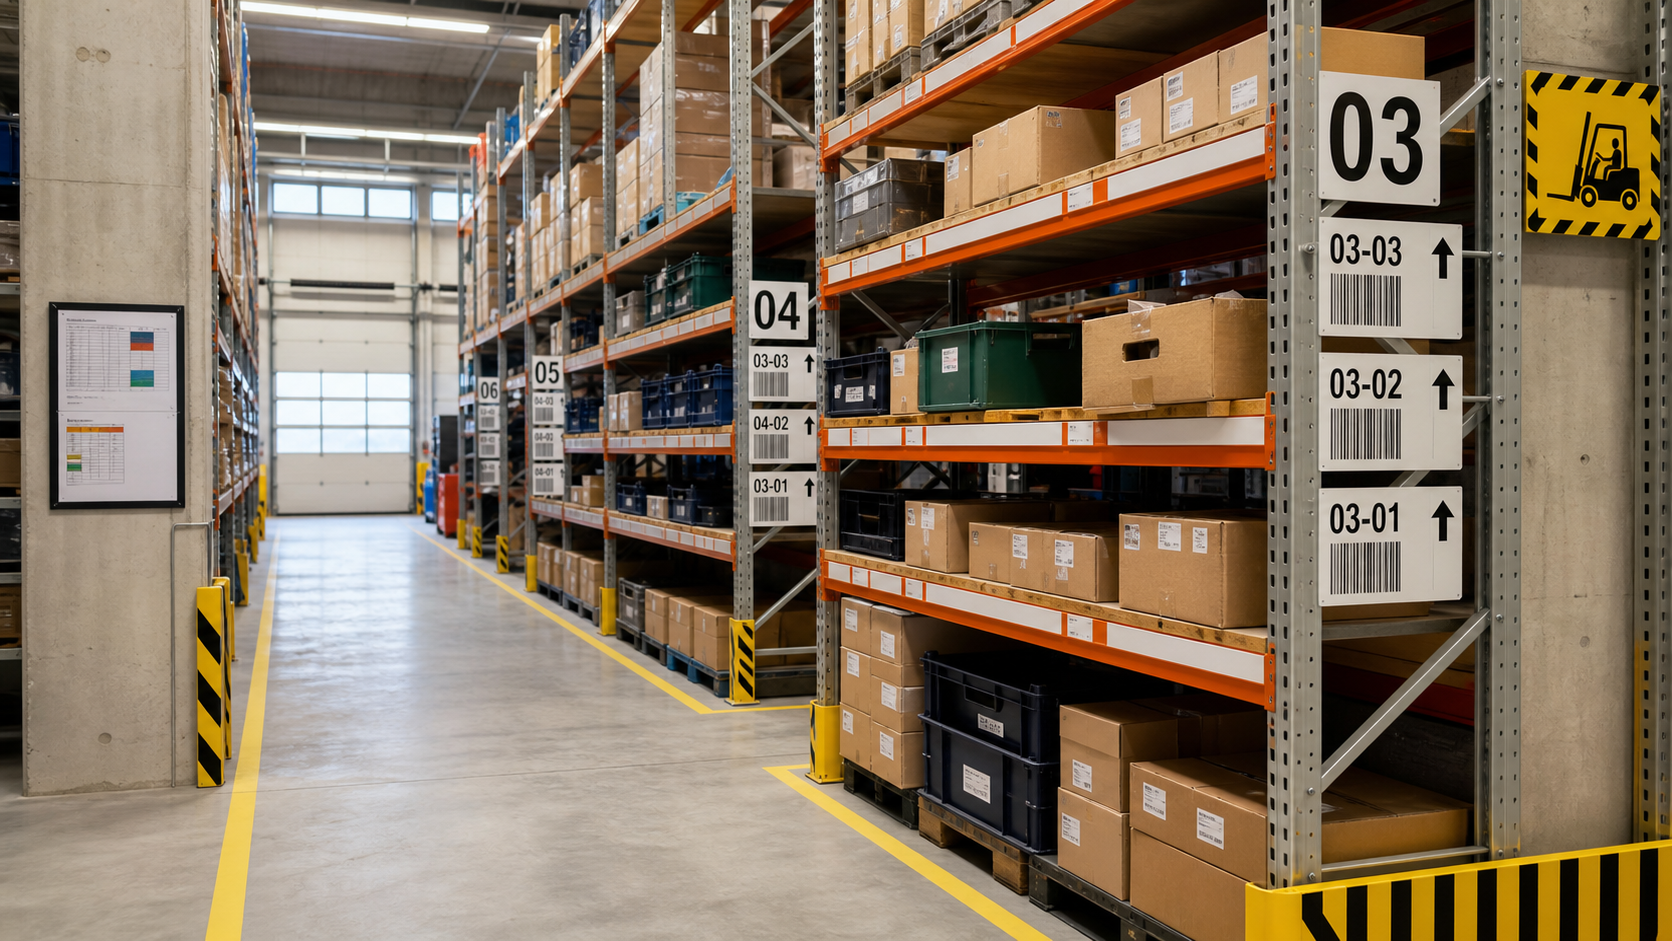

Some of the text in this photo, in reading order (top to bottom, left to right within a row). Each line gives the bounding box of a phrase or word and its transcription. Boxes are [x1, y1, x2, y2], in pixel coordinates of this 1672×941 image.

[1329, 91, 1424, 186] 03
[1329, 232, 1402, 267] 03-03
[754, 289, 801, 331] 04
[534, 360, 560, 385] 05
[753, 353, 789, 369] 03-03
[480, 381, 498, 400] 06
[1329, 367, 1403, 400] 03-02
[753, 415, 789, 431] 04-02
[753, 478, 788, 494] 03-01
[1329, 501, 1400, 535] 03-01
